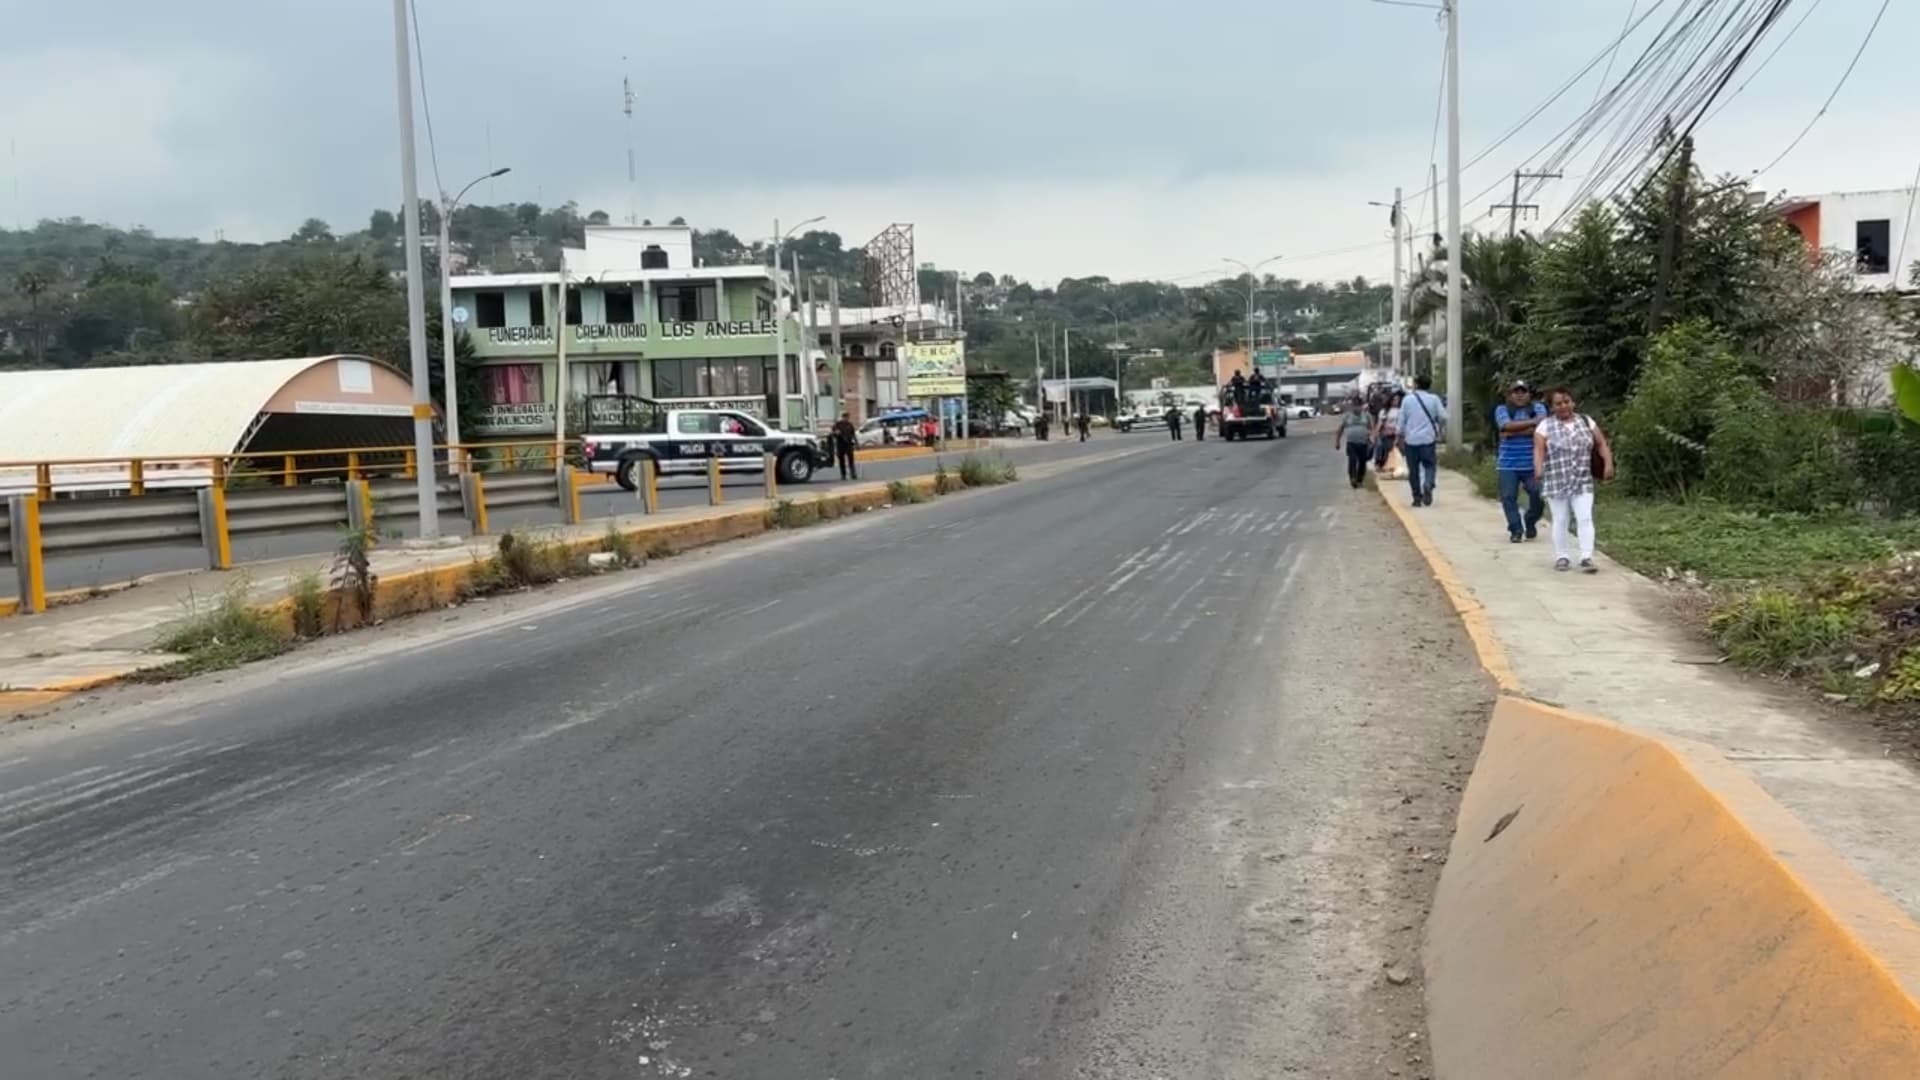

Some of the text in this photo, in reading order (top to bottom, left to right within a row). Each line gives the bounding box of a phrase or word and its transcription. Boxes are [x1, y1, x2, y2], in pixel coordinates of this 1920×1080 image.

[488, 319, 778, 343] FUNERARIA CREMATORIO LOS ANGELES
